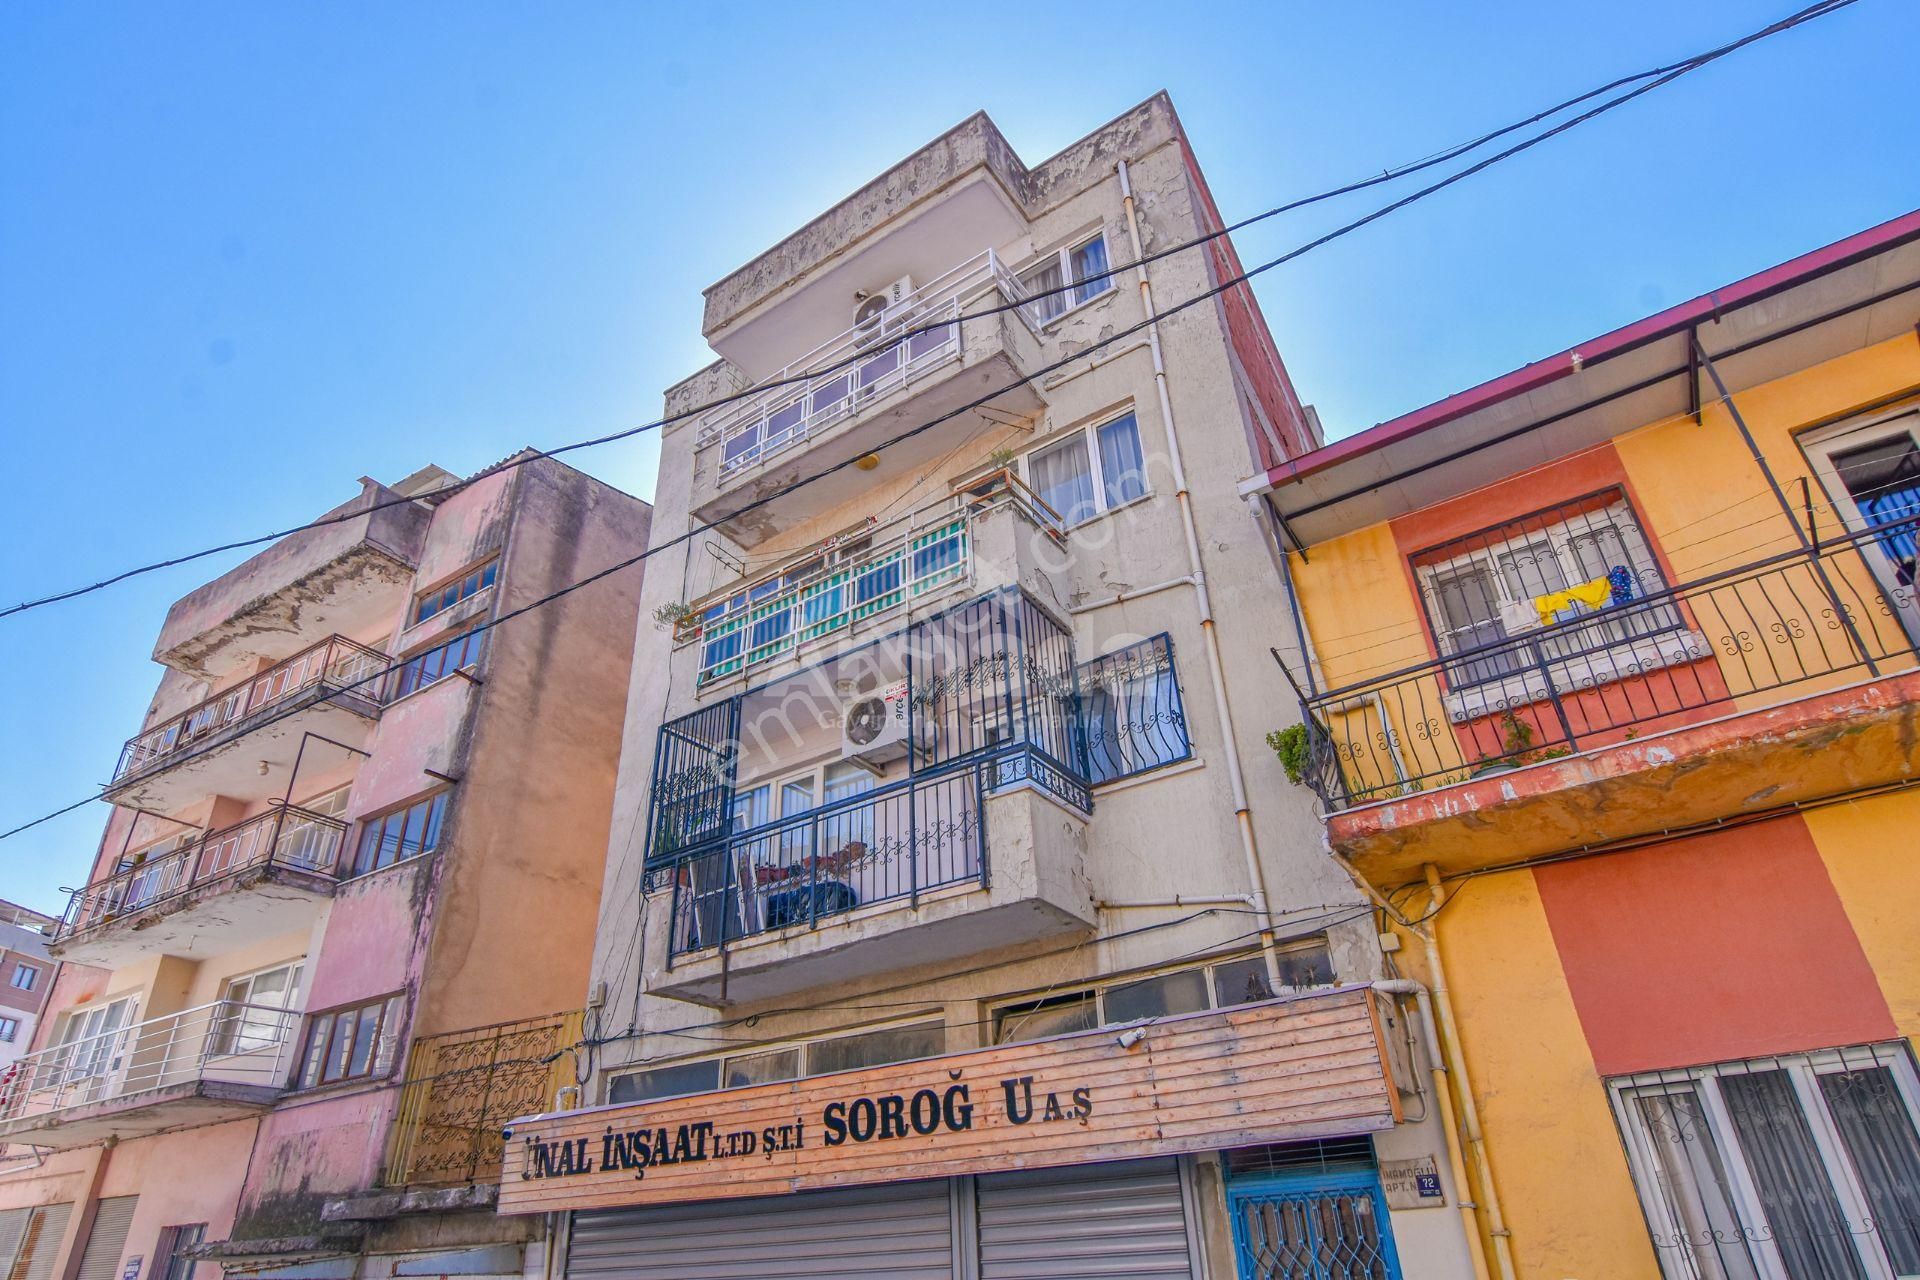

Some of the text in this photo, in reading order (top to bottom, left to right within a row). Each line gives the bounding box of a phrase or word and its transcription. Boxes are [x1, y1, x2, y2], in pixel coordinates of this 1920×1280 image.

[521, 1135, 593, 1181] ÜNAL
[823, 1069, 974, 1147] SOROĞ
[1423, 1178, 1435, 1188] 72
